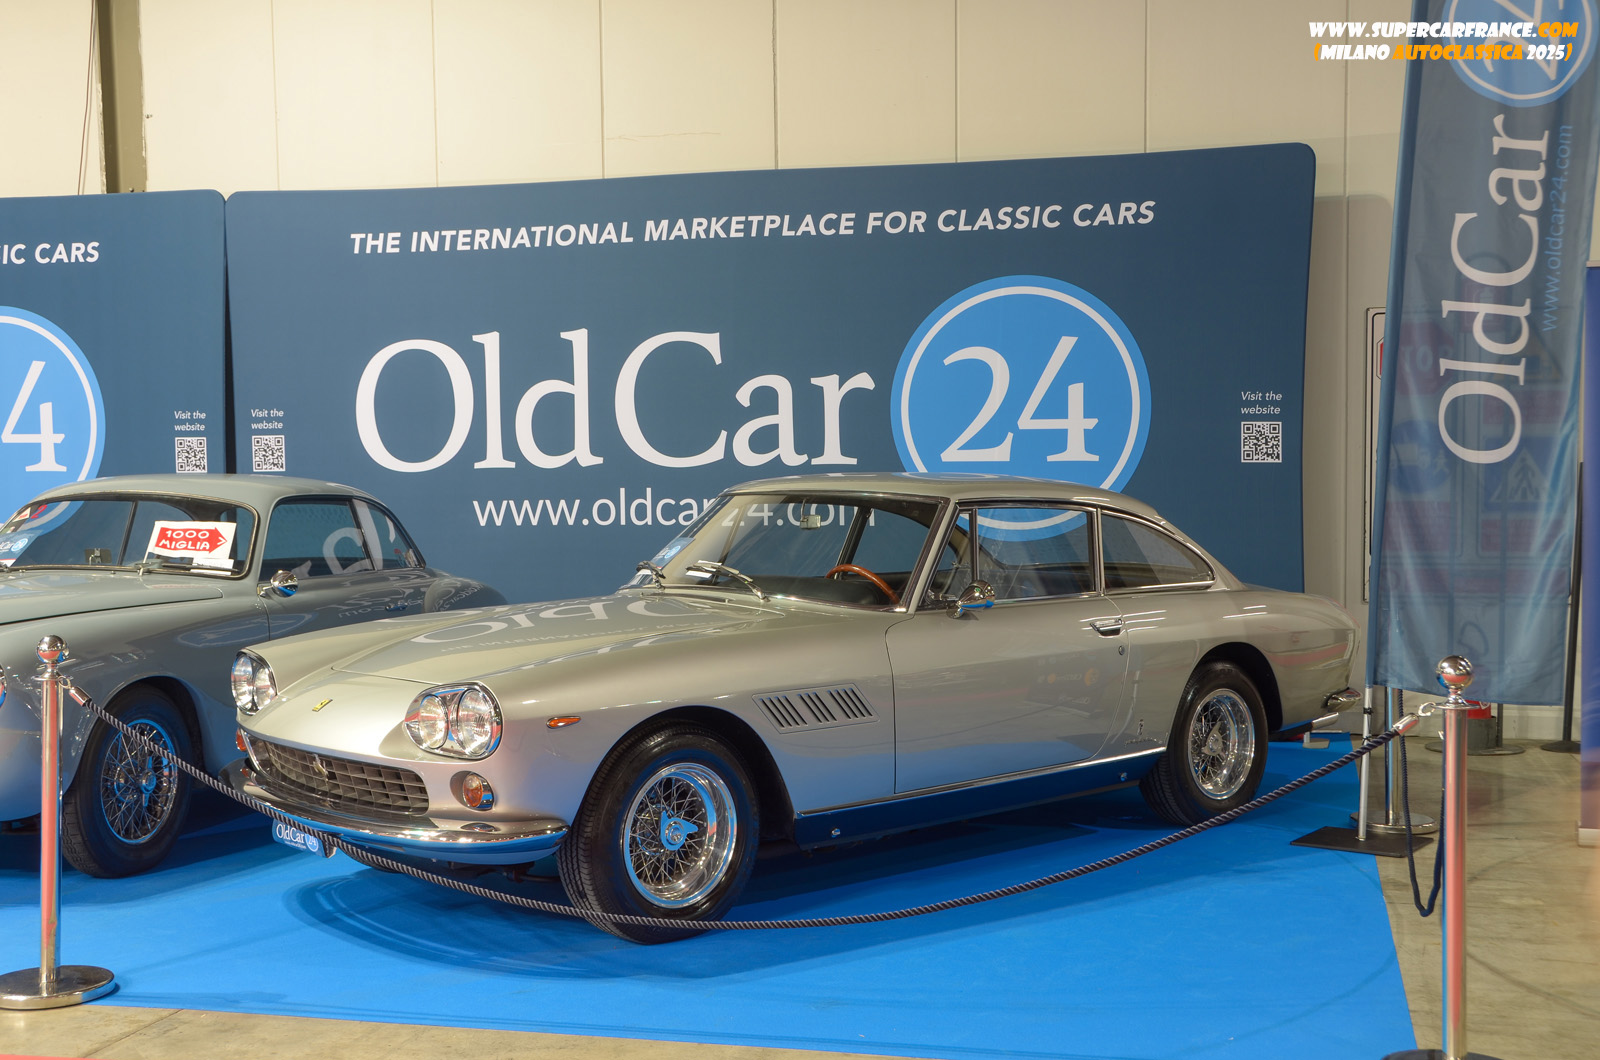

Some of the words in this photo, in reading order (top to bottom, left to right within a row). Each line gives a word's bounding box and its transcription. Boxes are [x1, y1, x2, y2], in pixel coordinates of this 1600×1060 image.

[350, 232, 401, 254] THE
[410, 222, 634, 253] INTERNATIONAL
[644, 213, 856, 242] MARKETPLACE
[866, 211, 927, 234] FOR
[937, 205, 1062, 232] CLASSIC
[1073, 201, 1156, 227] CARS
[1541, 125, 1573, 331] www.oldcar24.com
[0, 244, 27, 264] IC
[34, 241, 100, 264] CARS
[1438, 114, 1549, 464] OldCar
[356, 328, 875, 473] OldCar
[940, 336, 1100, 463] 24
[1241, 390, 1263, 401] Visit
[1265, 390, 1283, 401] the
[250, 408, 268, 418] Visit
[270, 408, 285, 418] the
[1241, 404, 1281, 414] website
[174, 410, 191, 420] Visit
[193, 410, 207, 420] the
[174, 422, 206, 431] website
[250, 420, 284, 430] website
[165, 530, 210, 539] 1000
[158, 539, 210, 550] MIGLIA
[276, 823, 305, 843] OldCar
